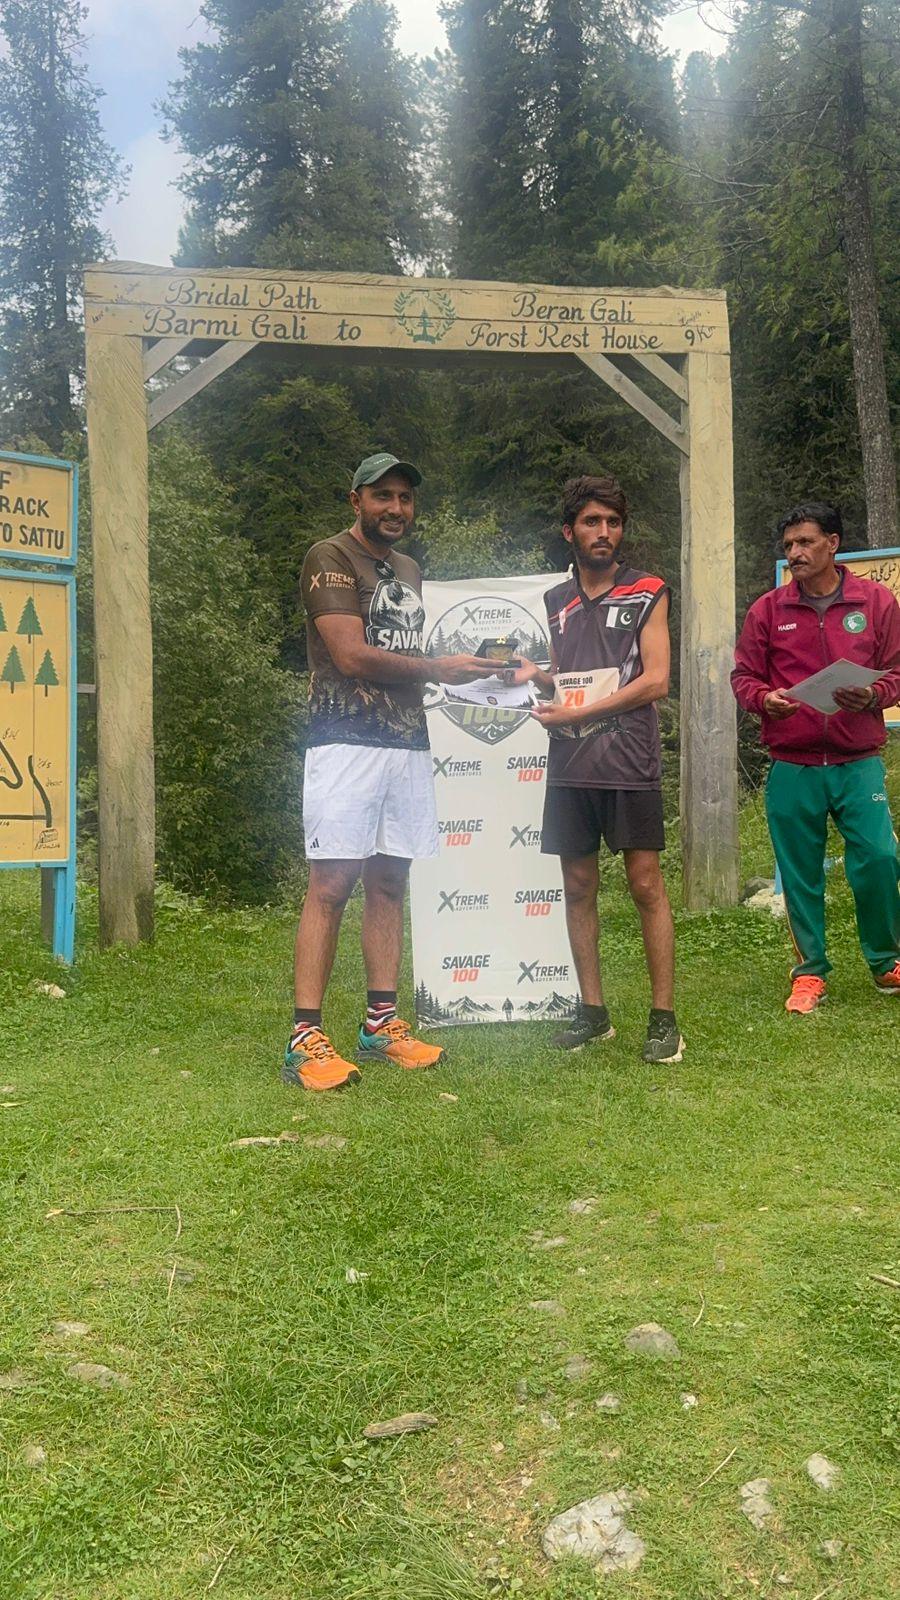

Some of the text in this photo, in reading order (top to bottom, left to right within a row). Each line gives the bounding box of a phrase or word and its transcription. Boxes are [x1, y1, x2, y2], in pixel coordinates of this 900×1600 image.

[166, 278, 249, 305] Bridal
[258, 281, 321, 310] Path
[511, 292, 635, 323] Beran Gali
[143, 305, 362, 341] Barmi Gali to
[465, 322, 663, 350] Forst Rest House
[684, 329, 695, 346] 9
[0, 495, 49, 518] RACK
[0, 522, 64, 550] O SATTU
[461, 605, 512, 626] XTREME
[559, 677, 582, 686] SAVAGE
[564, 690, 585, 708] 20
[433, 755, 482, 778] XTREME
[507, 755, 548, 770] SAVAG
[517, 768, 544, 782] 100
[438, 819, 483, 834] SAVAGE
[446, 833, 472, 847] 100
[509, 824, 541, 849] XTR
[437, 889, 489, 914] XTREME
[514, 889, 563, 904] SAVAGE
[525, 903, 552, 917] 100
[442, 954, 491, 970] SAVAGE
[452, 968, 479, 983] 100
[517, 959, 570, 985] XTREME
